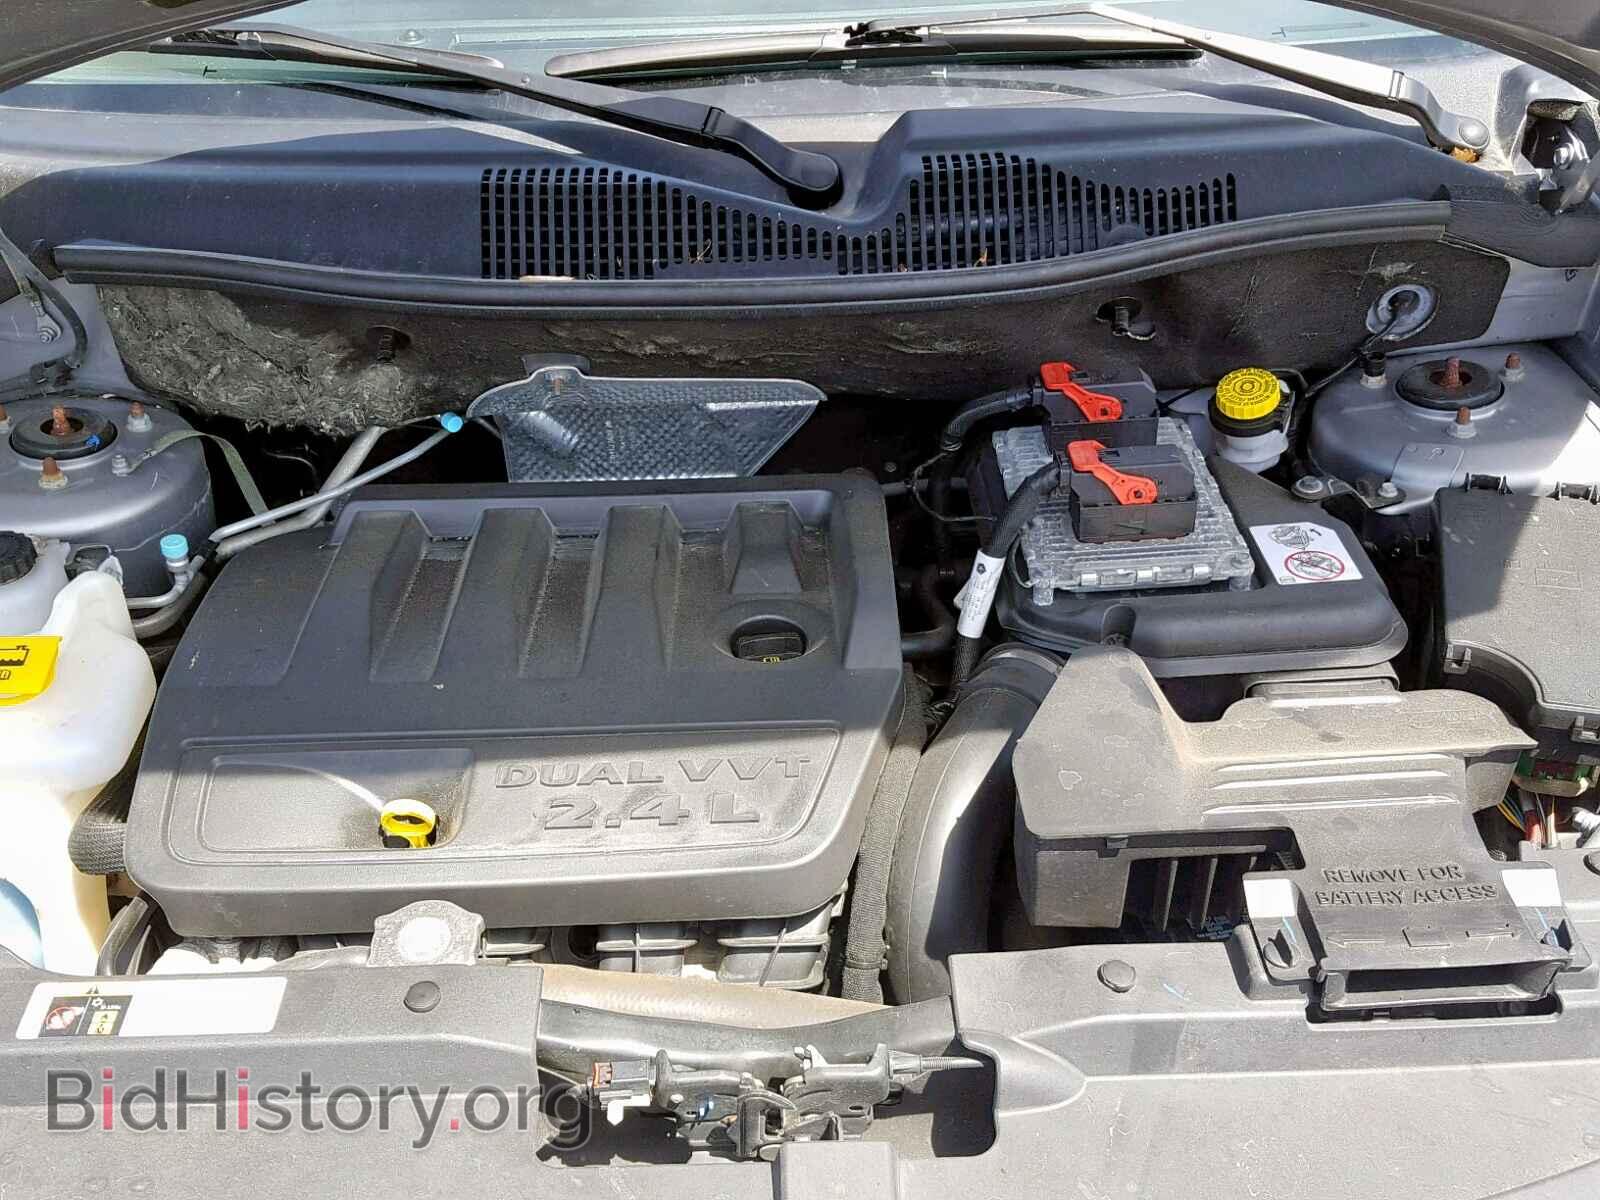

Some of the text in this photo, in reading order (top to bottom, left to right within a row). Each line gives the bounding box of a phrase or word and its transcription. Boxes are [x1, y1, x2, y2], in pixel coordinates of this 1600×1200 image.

[495, 757, 811, 788] DUAL VVT
[1323, 865, 1464, 884] REMOVE FOR
[1315, 885, 1498, 906] BATTERY ACCESS
